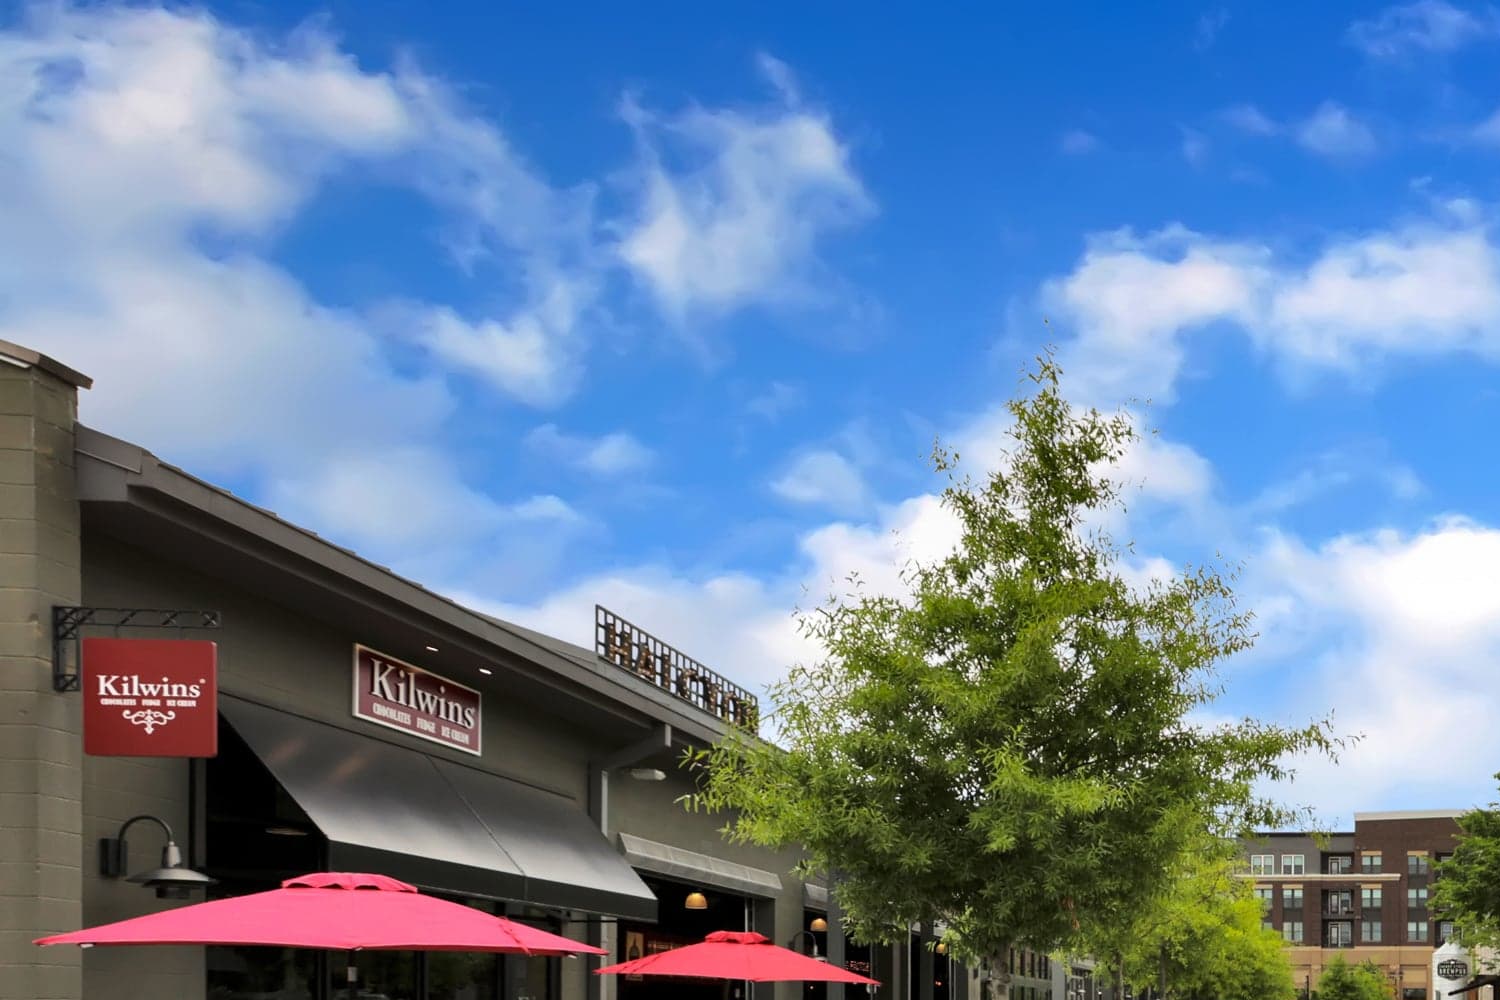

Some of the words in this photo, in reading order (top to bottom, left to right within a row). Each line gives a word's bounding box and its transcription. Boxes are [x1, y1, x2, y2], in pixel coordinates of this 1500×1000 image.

[96, 674, 201, 698] Kilwins
[370, 658, 475, 729] Kilwins
[372, 702, 411, 725] CHOCOLATES
